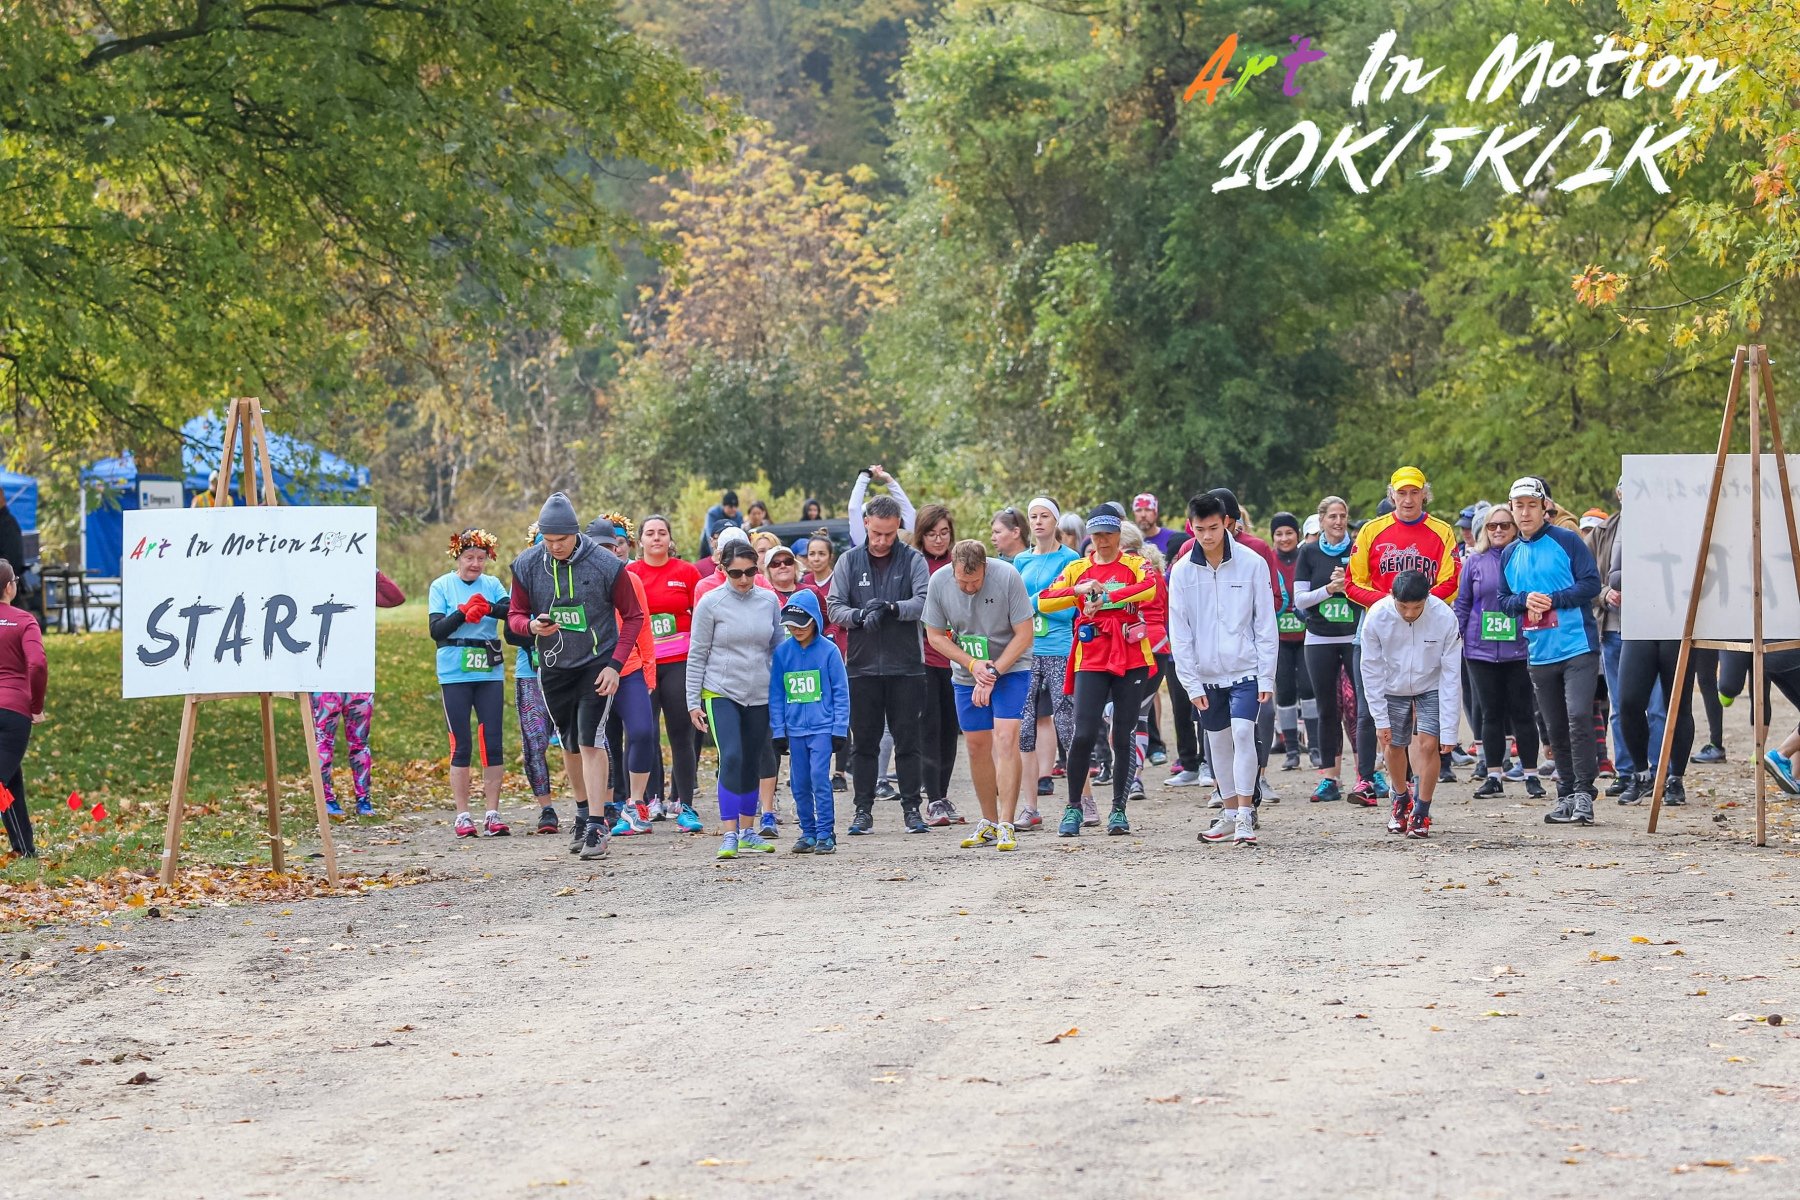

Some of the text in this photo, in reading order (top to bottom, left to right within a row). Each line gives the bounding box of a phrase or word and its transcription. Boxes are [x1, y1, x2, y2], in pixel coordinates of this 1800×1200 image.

[130, 536, 172, 560] Art
[186, 532, 214, 558] In
[221, 532, 306, 557] Motion
[553, 611, 580, 625] 260
[1324, 603, 1349, 618] 214
[652, 618, 672, 635] 68
[1280, 617, 1301, 629] 225
[1486, 617, 1511, 632] 254
[136, 592, 358, 671] START
[960, 641, 984, 658] 216
[466, 653, 489, 669] 262
[788, 676, 815, 694] 250
